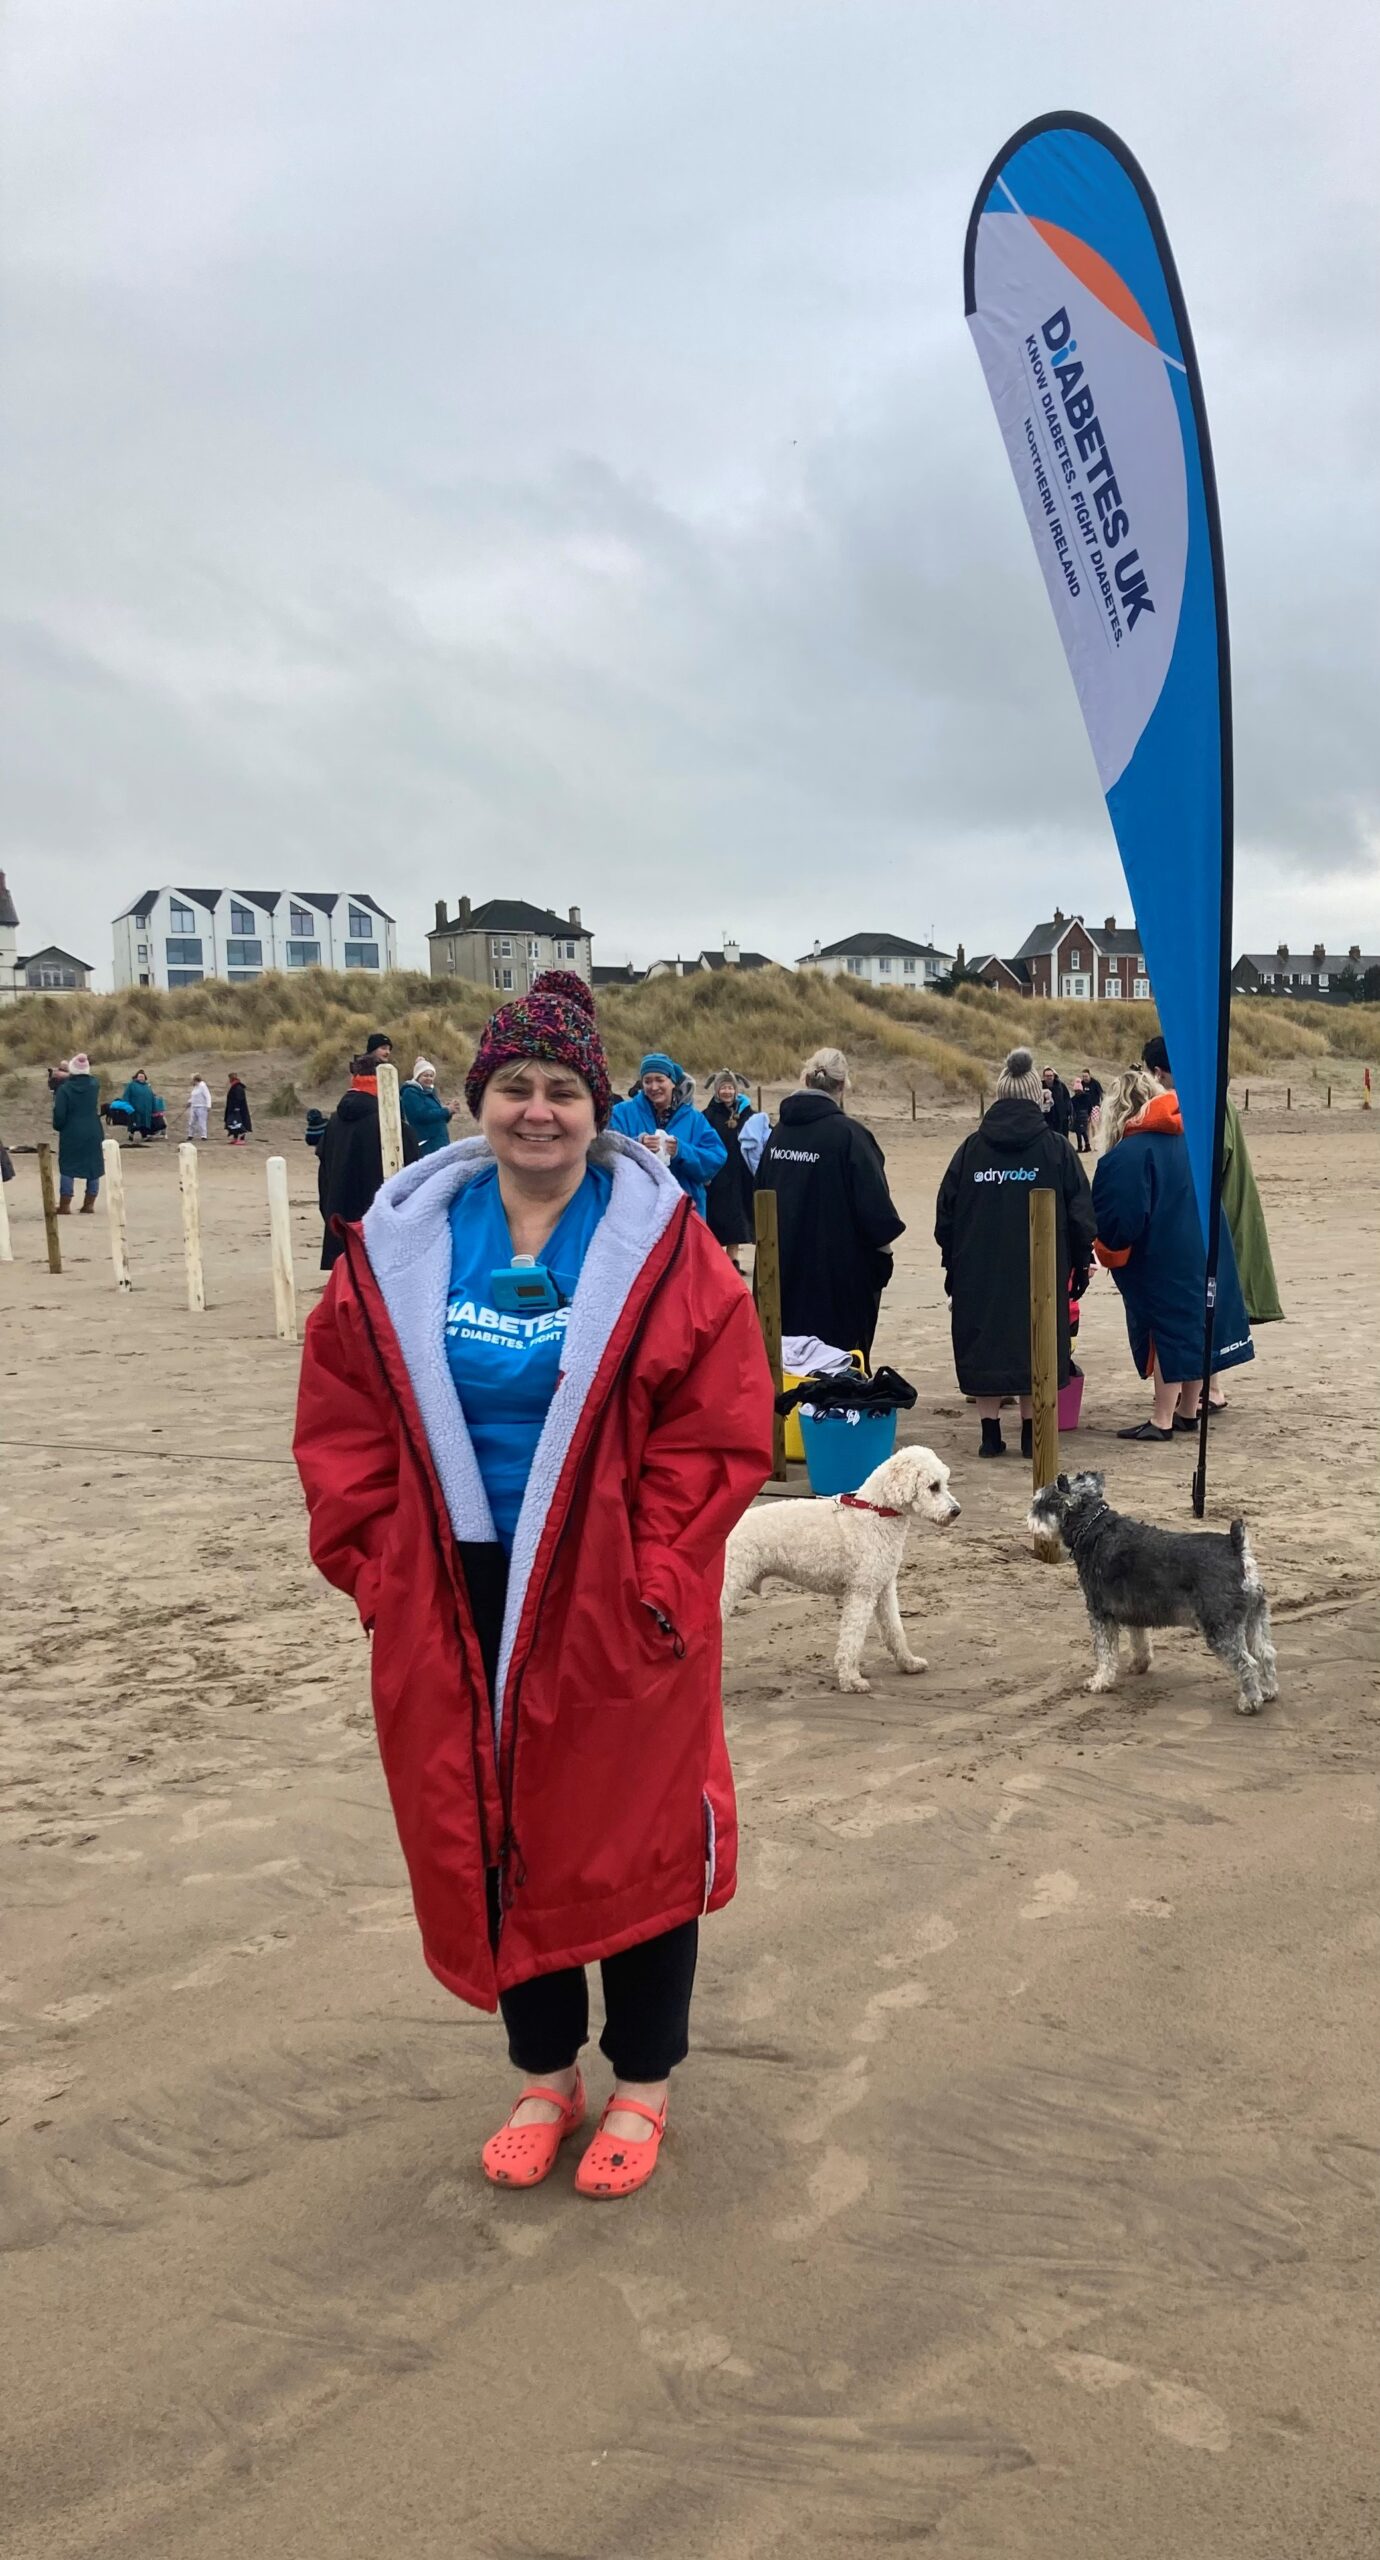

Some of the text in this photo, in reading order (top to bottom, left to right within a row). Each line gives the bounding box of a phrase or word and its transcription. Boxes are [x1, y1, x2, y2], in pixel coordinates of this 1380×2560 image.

[1024, 416, 1081, 598] NORTHERN IRELAND
[1025, 334, 1123, 648] KNOW DIABETES. FIGHT DIABETES.
[1114, 548, 1156, 632] UK
[447, 1301, 573, 1338] iABETES
[460, 1327, 527, 1350] DIABETES.
